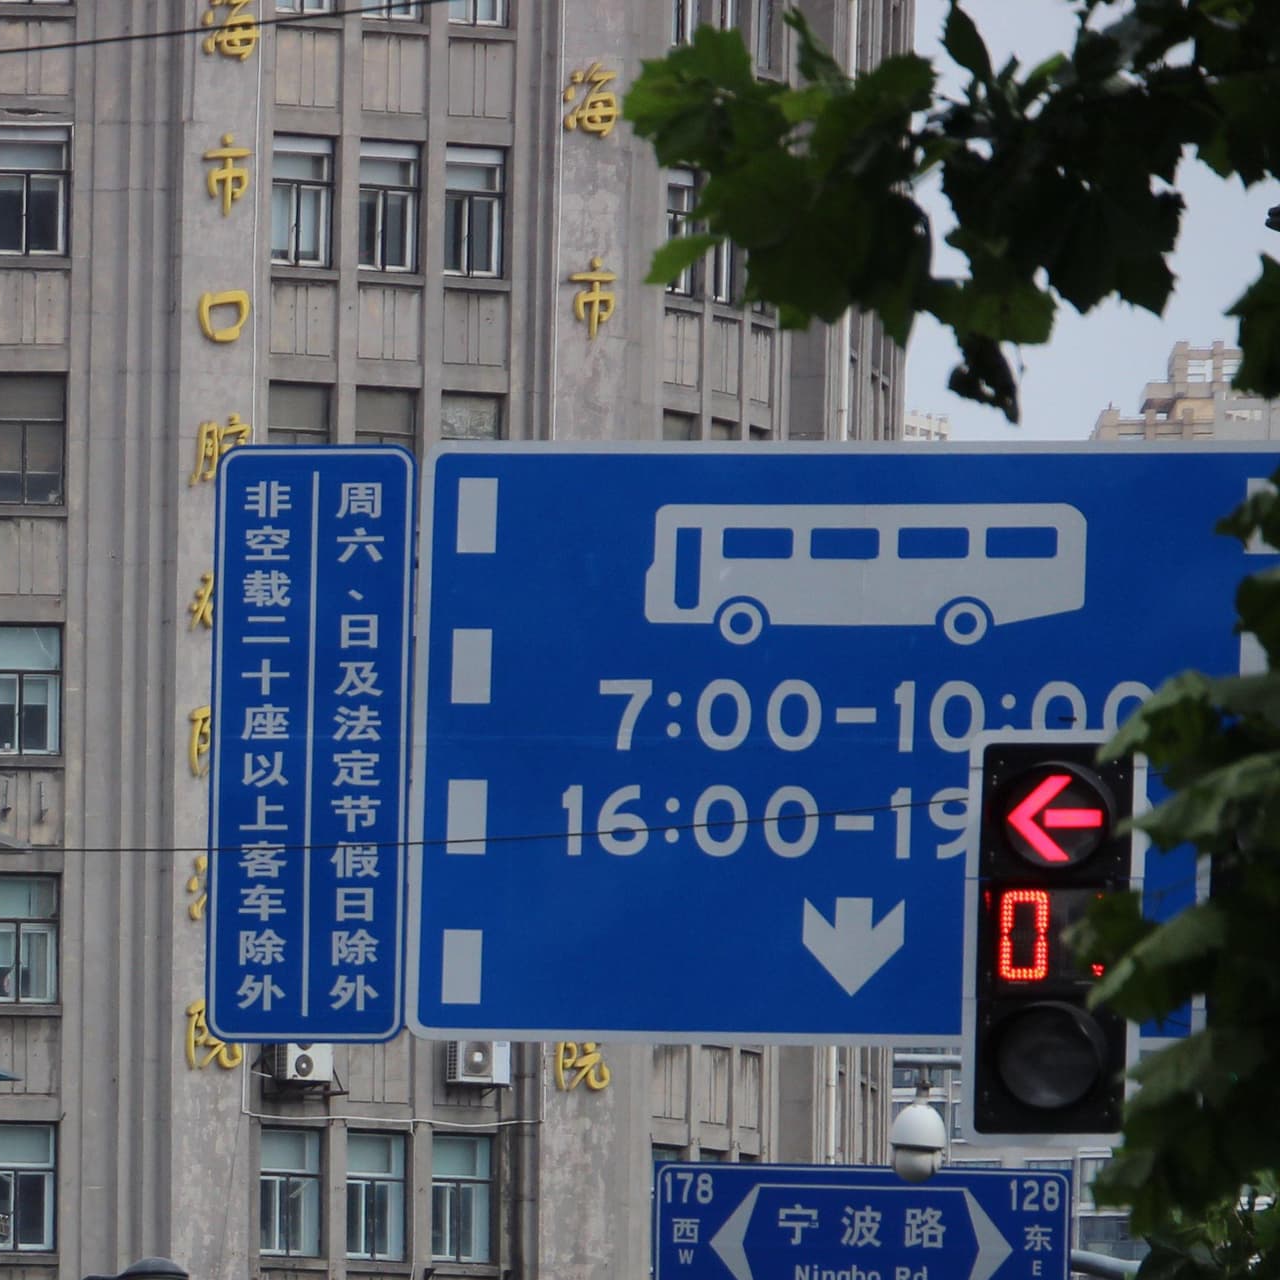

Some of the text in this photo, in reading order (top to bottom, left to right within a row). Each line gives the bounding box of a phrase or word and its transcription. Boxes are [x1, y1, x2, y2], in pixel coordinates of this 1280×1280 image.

[236, 481, 293, 1012] 非空载二十座以上客车除外
[329, 481, 384, 1012] 周六、日及法定节假日除外
[664, 1172, 714, 1204] 178
[1010, 1179, 1060, 1212] 128
[672, 1217, 700, 1244] 西
[777, 1203, 947, 1250] 宁波路
[1023, 1225, 1053, 1252] 东
[678, 1248, 694, 1265] W
[1032, 1259, 1042, 1276] E
